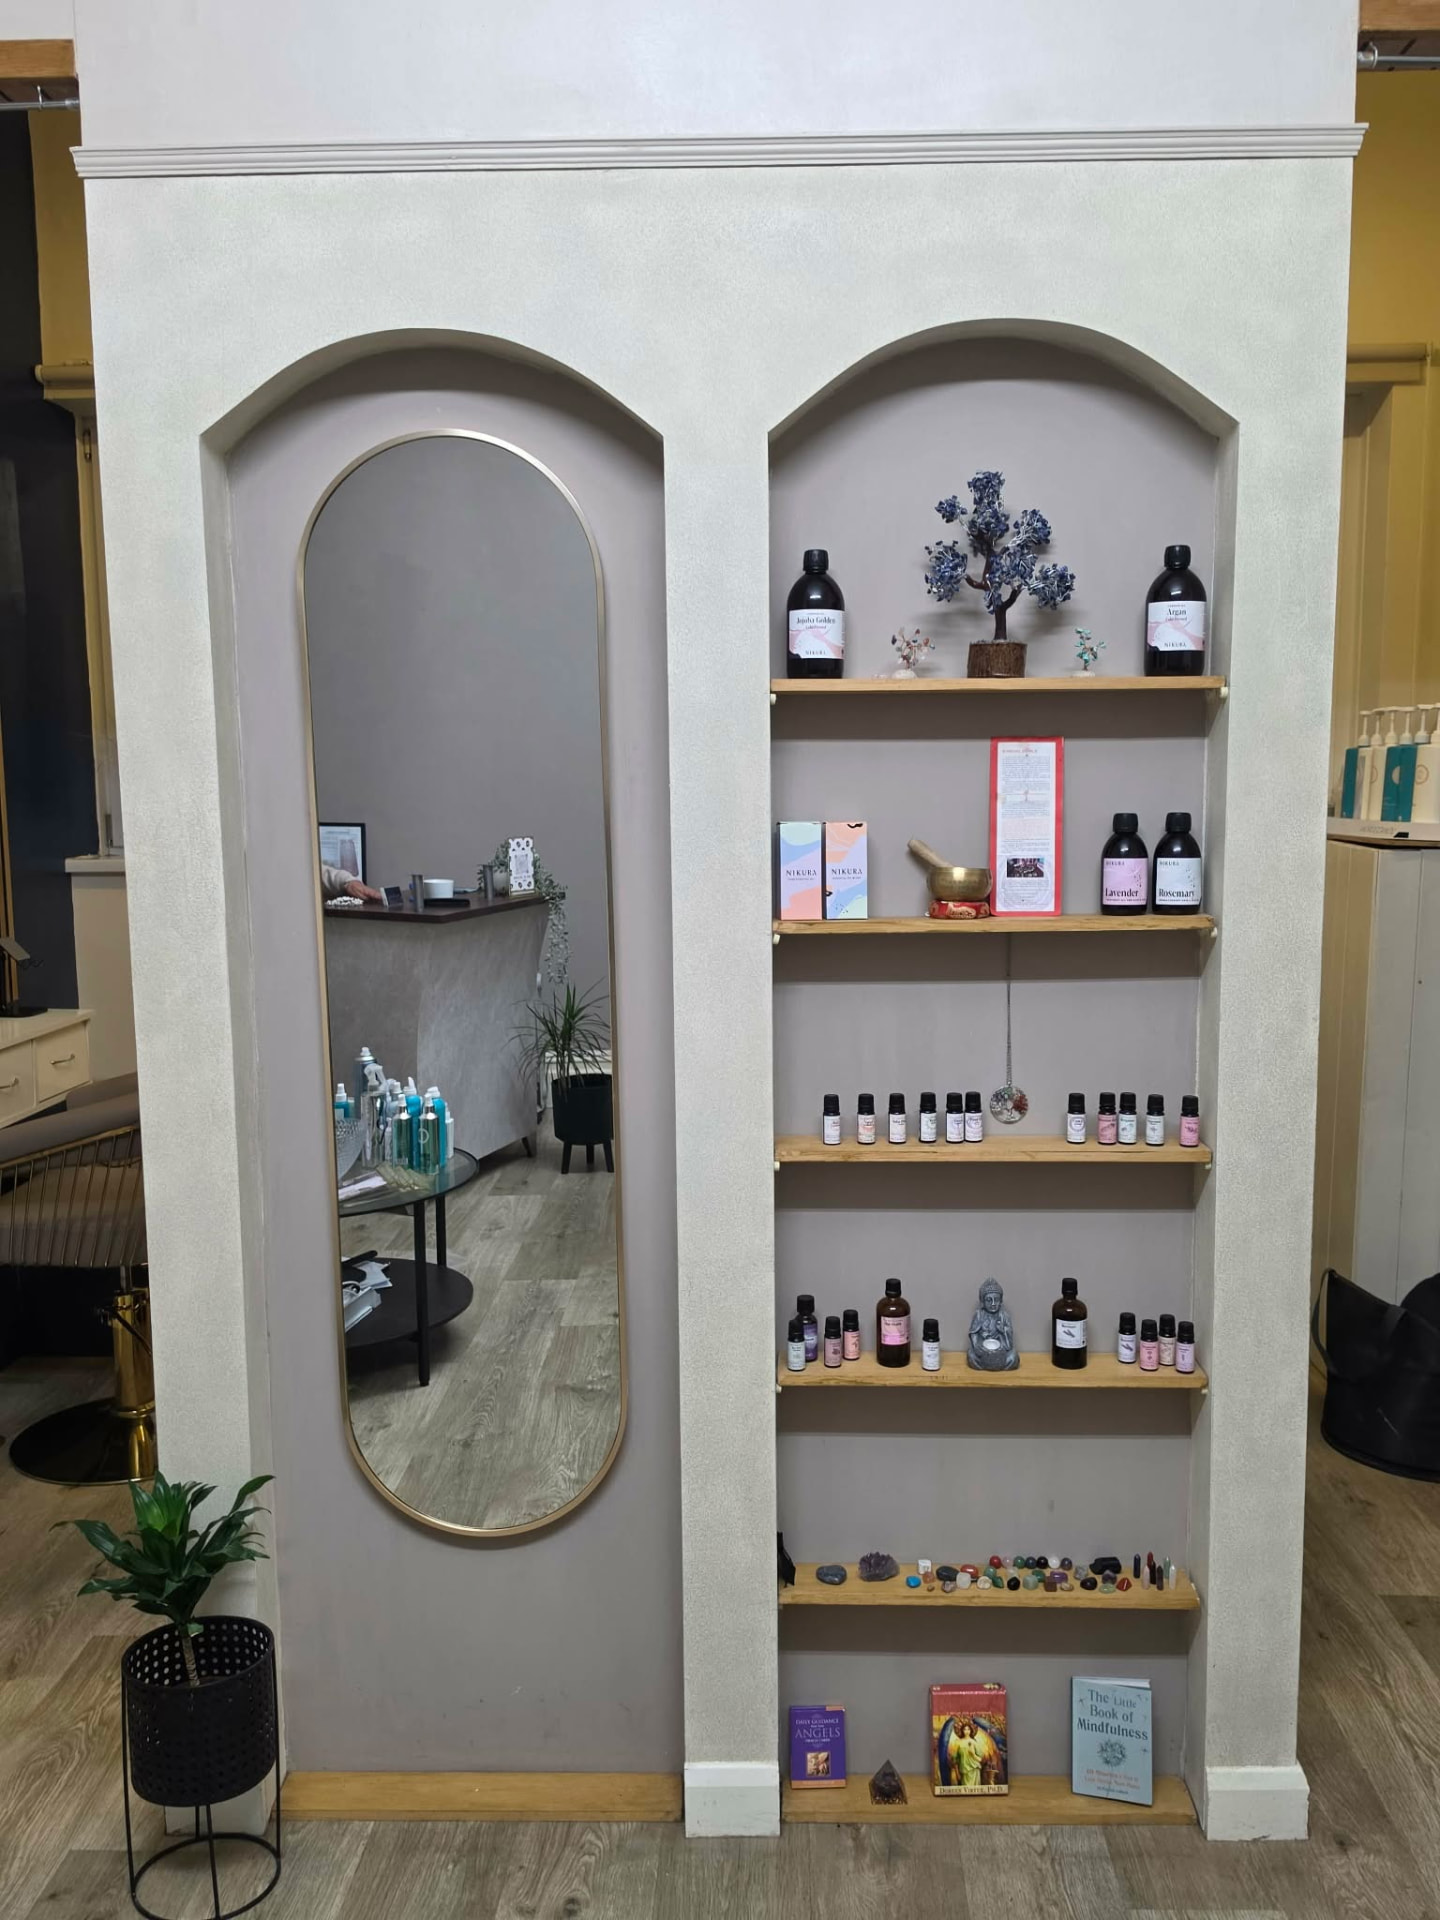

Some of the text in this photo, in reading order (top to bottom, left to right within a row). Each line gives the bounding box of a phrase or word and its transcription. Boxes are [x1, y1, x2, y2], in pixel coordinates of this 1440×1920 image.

[1167, 608, 1187, 616] Argan
[786, 869, 817, 877] NIKURA
[831, 868, 863, 876] NIKURA
[1105, 888, 1139, 897] Lavender
[1158, 888, 1195, 898] Rosemary
[1088, 1689, 1137, 1709] The Little
[1090, 1704, 1134, 1724] Book of
[795, 1727, 841, 1739] ANGELS
[1077, 1717, 1149, 1741] Mindfulness
